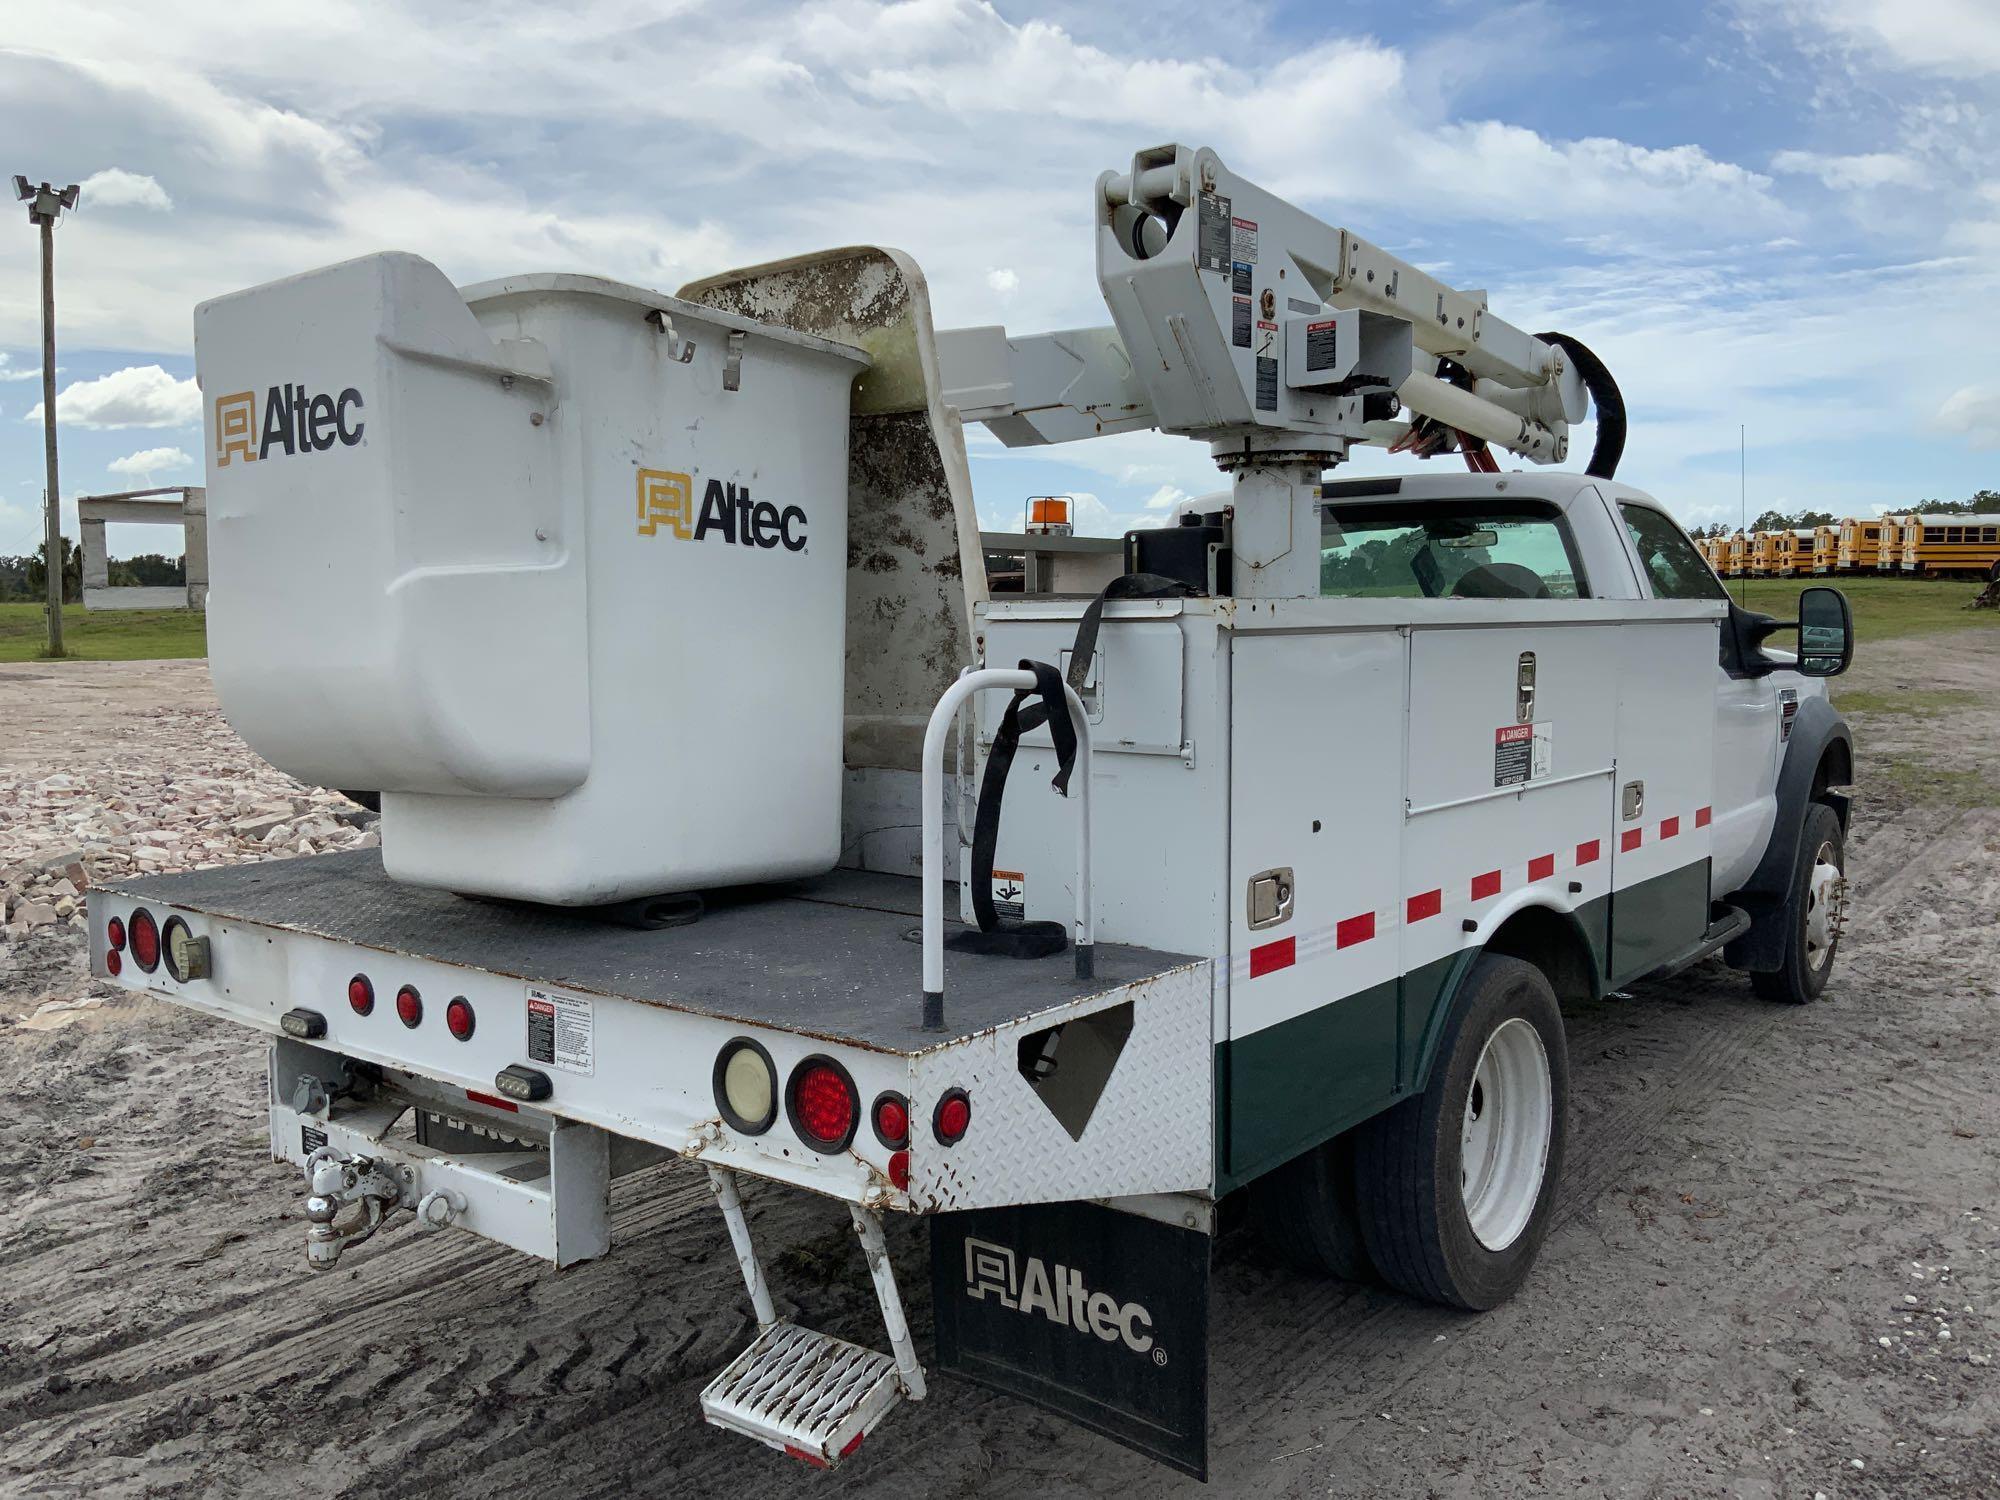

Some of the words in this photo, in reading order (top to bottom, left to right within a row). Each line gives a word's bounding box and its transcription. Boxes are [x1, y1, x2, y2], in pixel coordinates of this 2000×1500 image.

[259, 383, 365, 460] Altec
[694, 479, 807, 552] Altec
[1506, 728, 1529, 740] DANGER
[533, 1001, 554, 1013] DANGER
[1019, 1257, 1153, 1352] Altec
